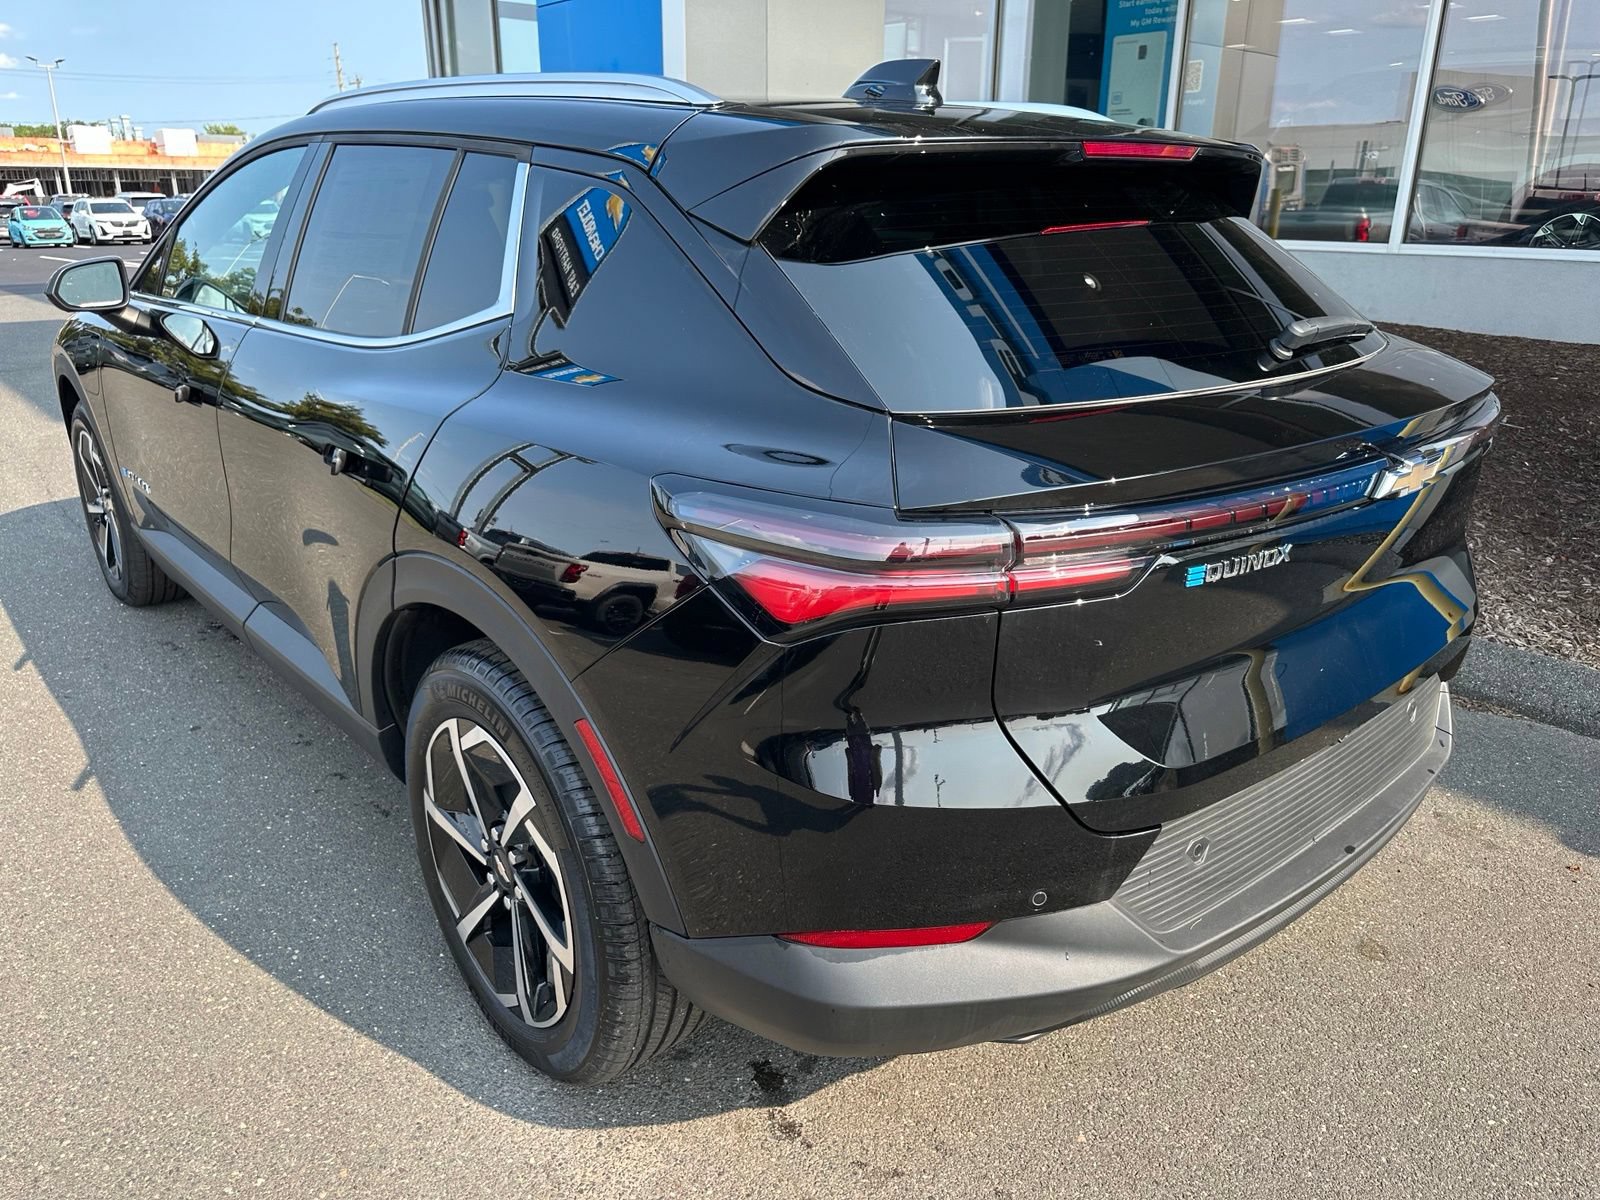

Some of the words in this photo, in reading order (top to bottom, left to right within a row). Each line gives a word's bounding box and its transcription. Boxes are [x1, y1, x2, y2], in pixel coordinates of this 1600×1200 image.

[1130, 19, 1140, 28] My
[1140, 17, 1152, 26] GM
[1185, 543, 1293, 588] EQUINOX
[447, 683, 508, 737] MICHELIN
